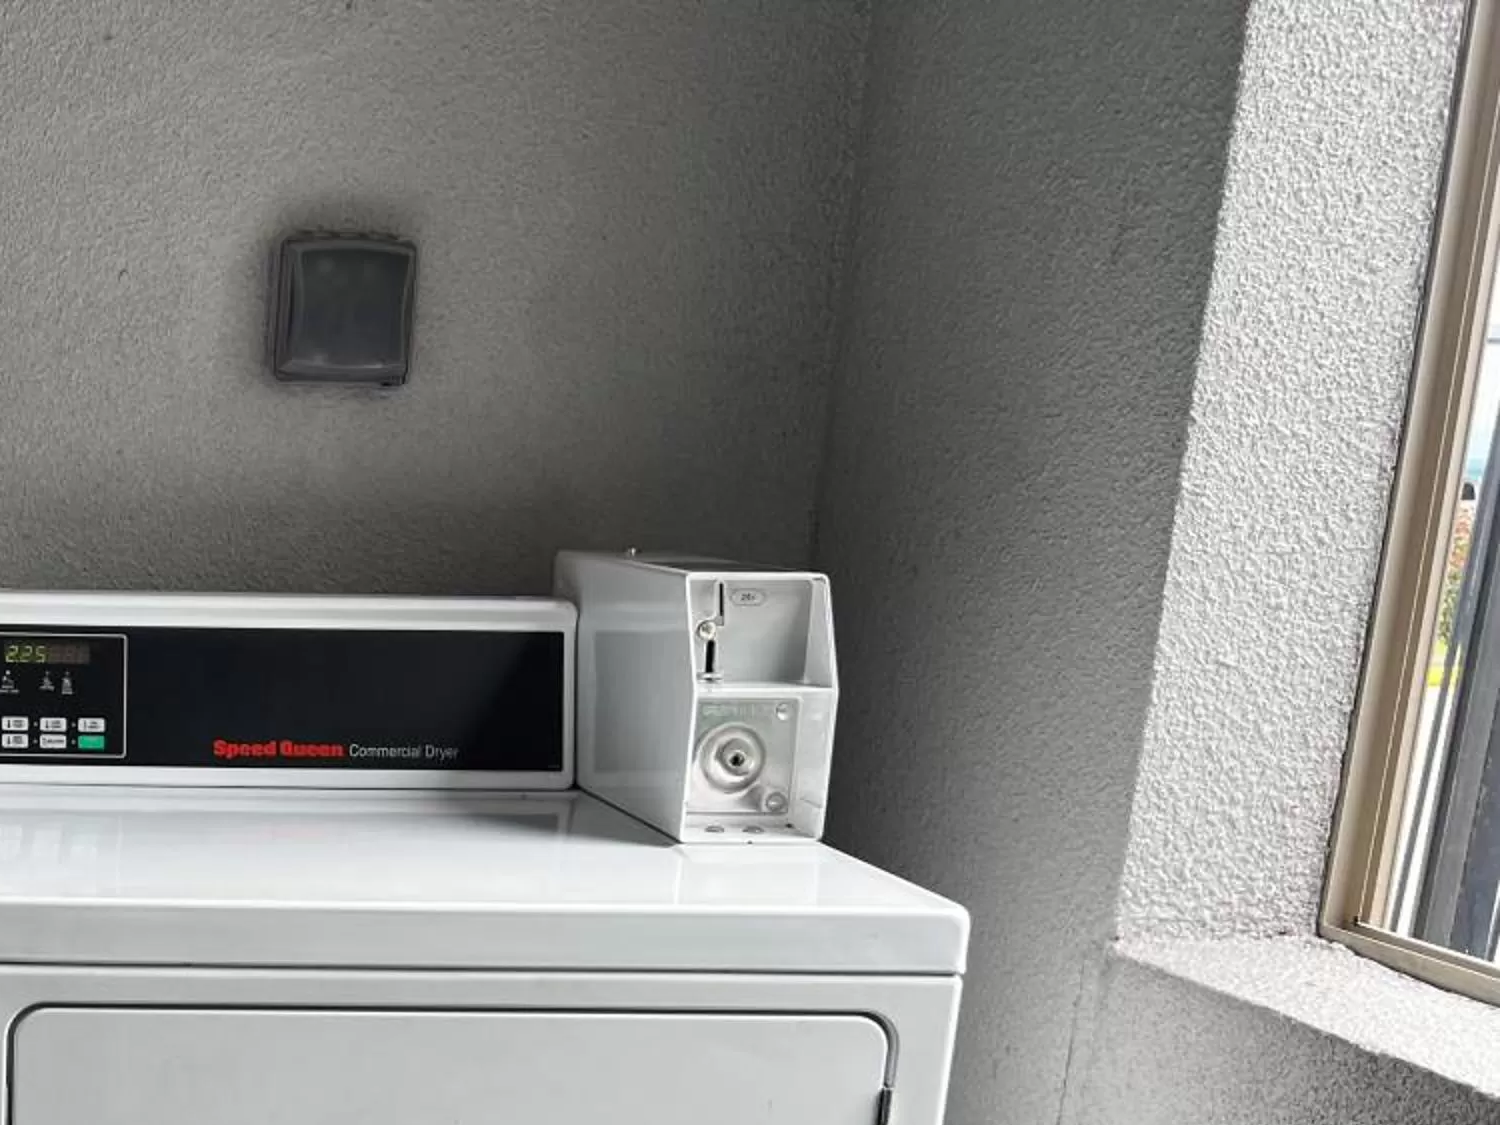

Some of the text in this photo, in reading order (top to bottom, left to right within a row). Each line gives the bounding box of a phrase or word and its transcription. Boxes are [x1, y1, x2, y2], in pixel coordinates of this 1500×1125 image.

[212, 739, 460, 760] Speed Queen Commercial Dryer
